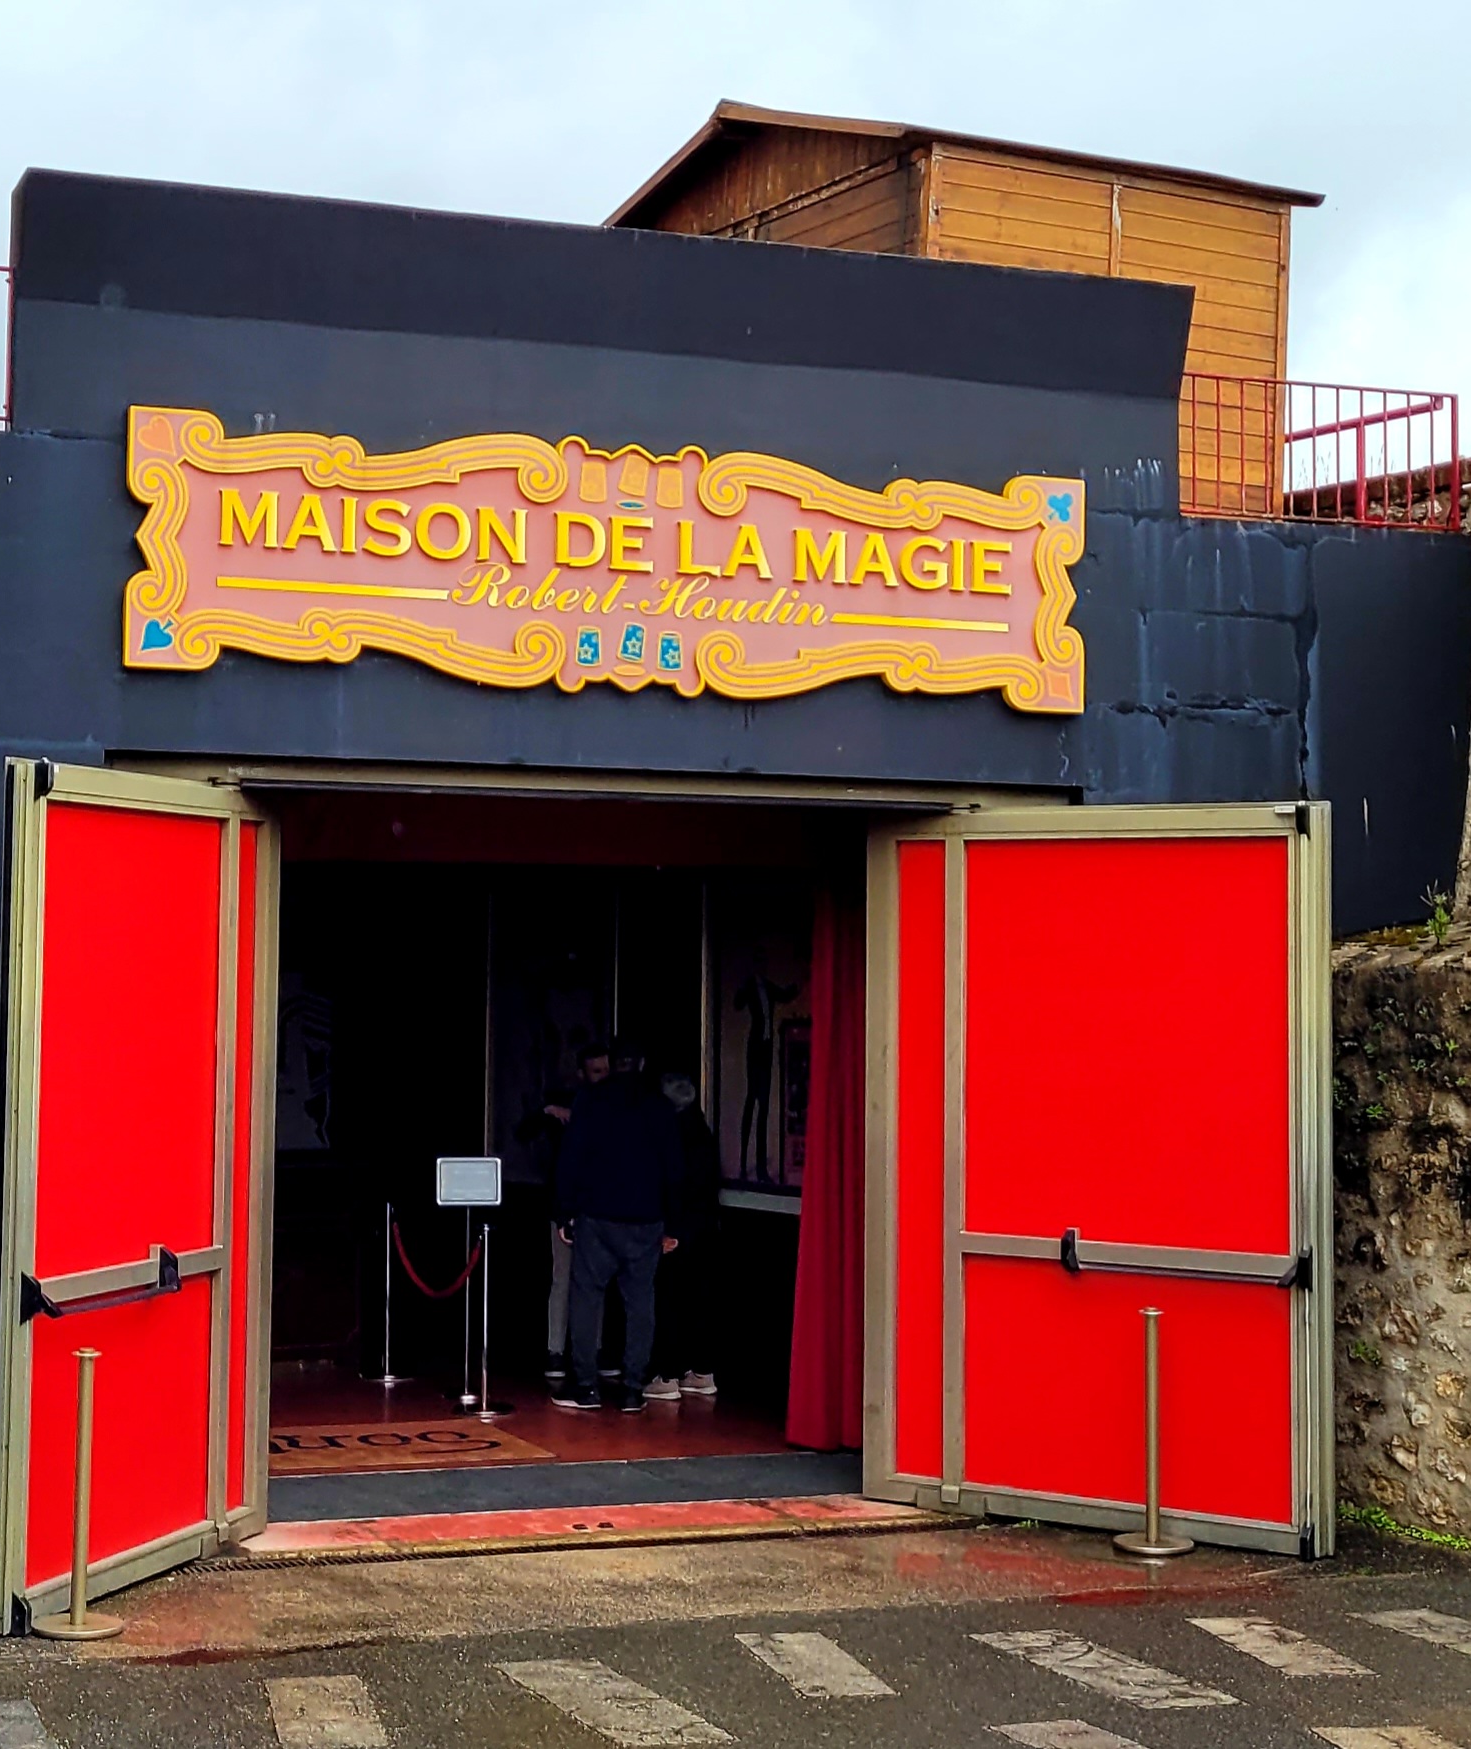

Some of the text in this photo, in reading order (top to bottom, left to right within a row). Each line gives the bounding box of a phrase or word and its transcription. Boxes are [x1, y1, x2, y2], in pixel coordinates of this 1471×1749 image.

[217, 487, 1013, 597] MAISON DE LA MAGIE
[450, 562, 829, 627] Robert-Houdin
